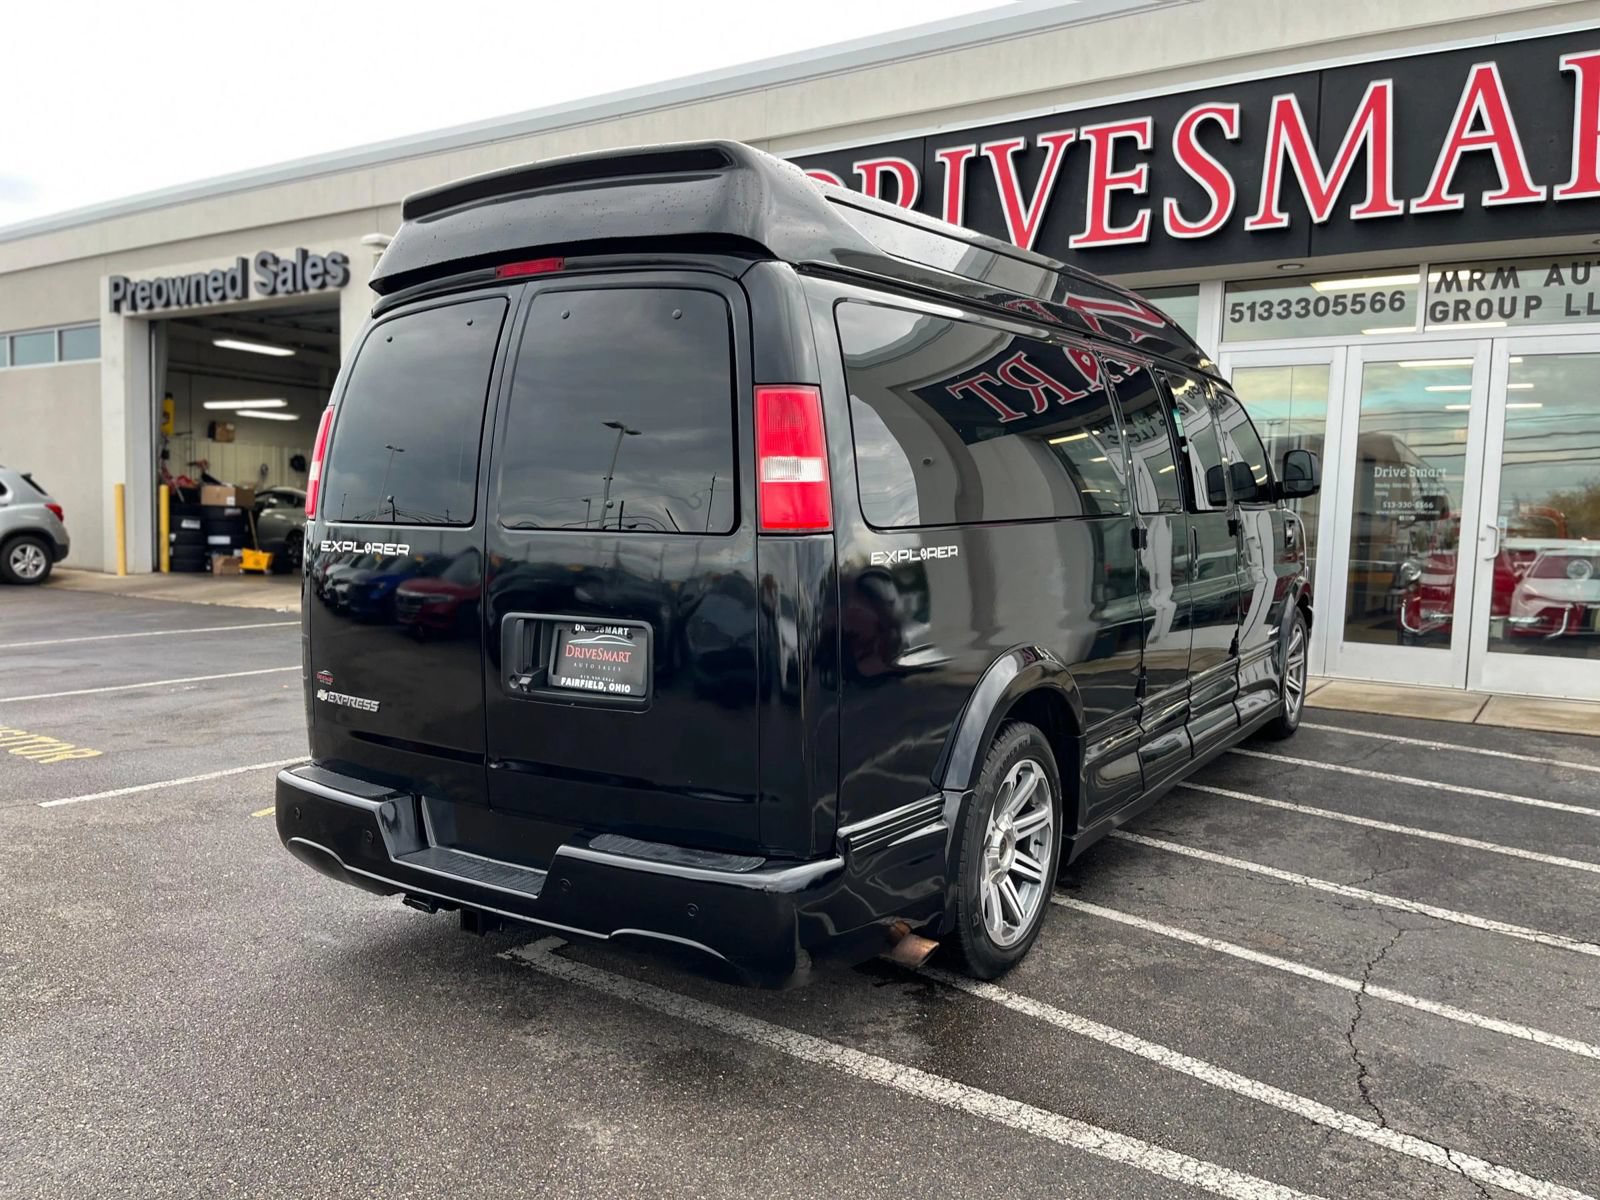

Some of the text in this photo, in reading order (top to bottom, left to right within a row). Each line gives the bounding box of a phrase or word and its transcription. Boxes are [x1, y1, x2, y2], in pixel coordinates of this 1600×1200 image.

[109, 248, 349, 313] Preowned Sales
[1434, 260, 1600, 294] MRM AU
[1230, 290, 1407, 323] 5133305566
[1429, 295, 1542, 323] GROUP
[1374, 466, 1448, 479] Drive Smart
[320, 540, 411, 556] EXPLORER
[870, 545, 959, 566] EXPLORER
[561, 677, 607, 692] FAIRFIELD,
[609, 683, 631, 693] OHIO
[327, 691, 381, 713] EXPRESS
